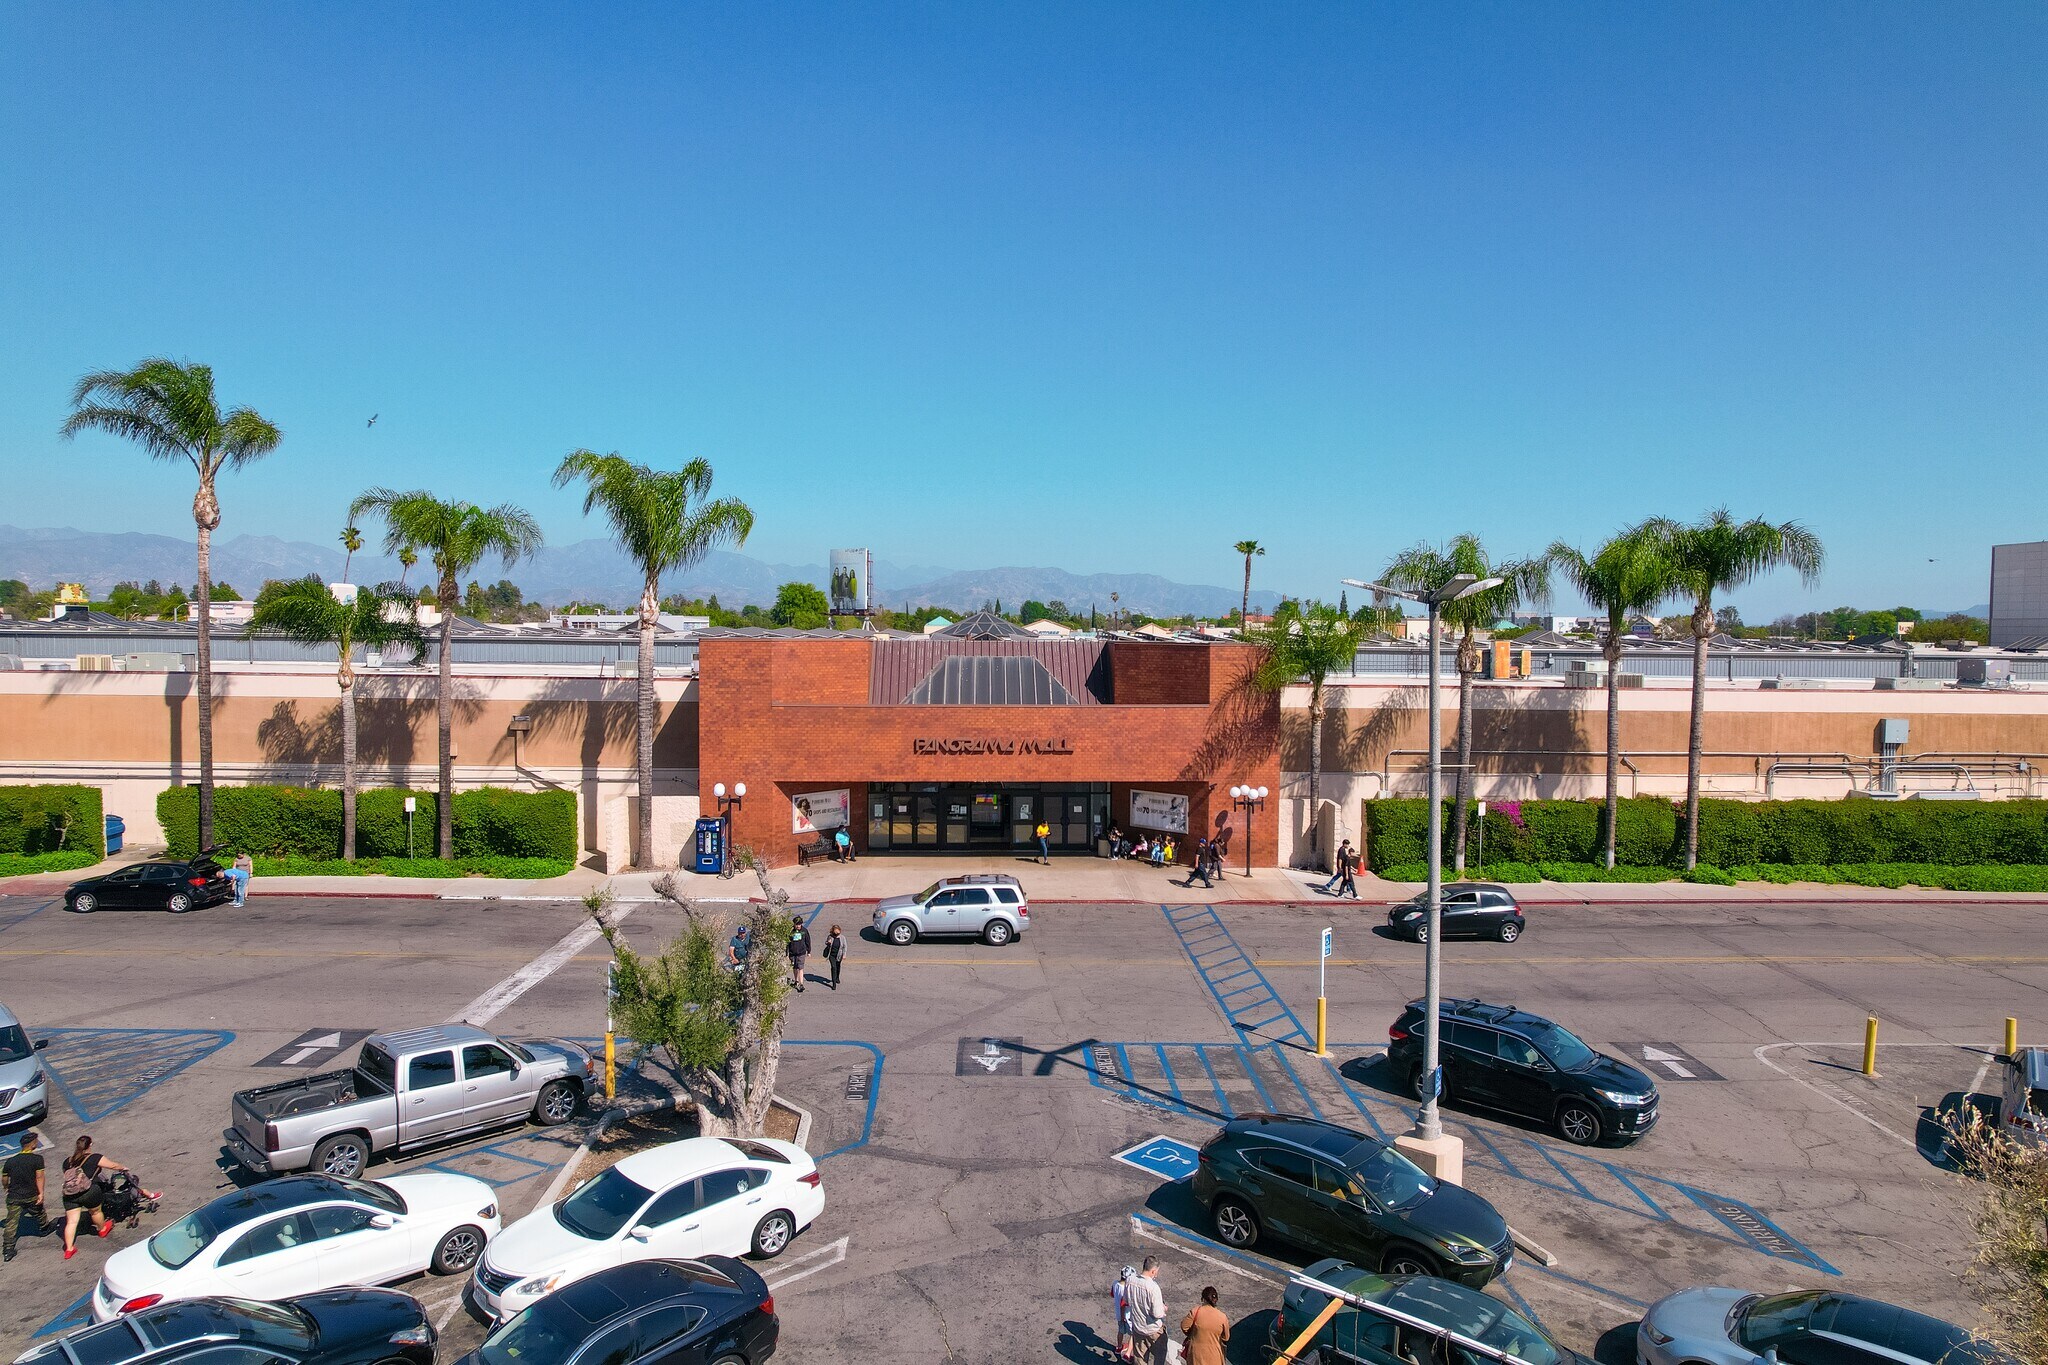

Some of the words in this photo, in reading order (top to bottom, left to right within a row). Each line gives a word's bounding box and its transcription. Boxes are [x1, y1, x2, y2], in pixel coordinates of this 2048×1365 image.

[914, 739, 1016, 755] PANORAMA
[1019, 739, 1073, 755] MALL
[1142, 806, 1150, 814] 70
[1718, 1206, 1796, 1254] PARKING
